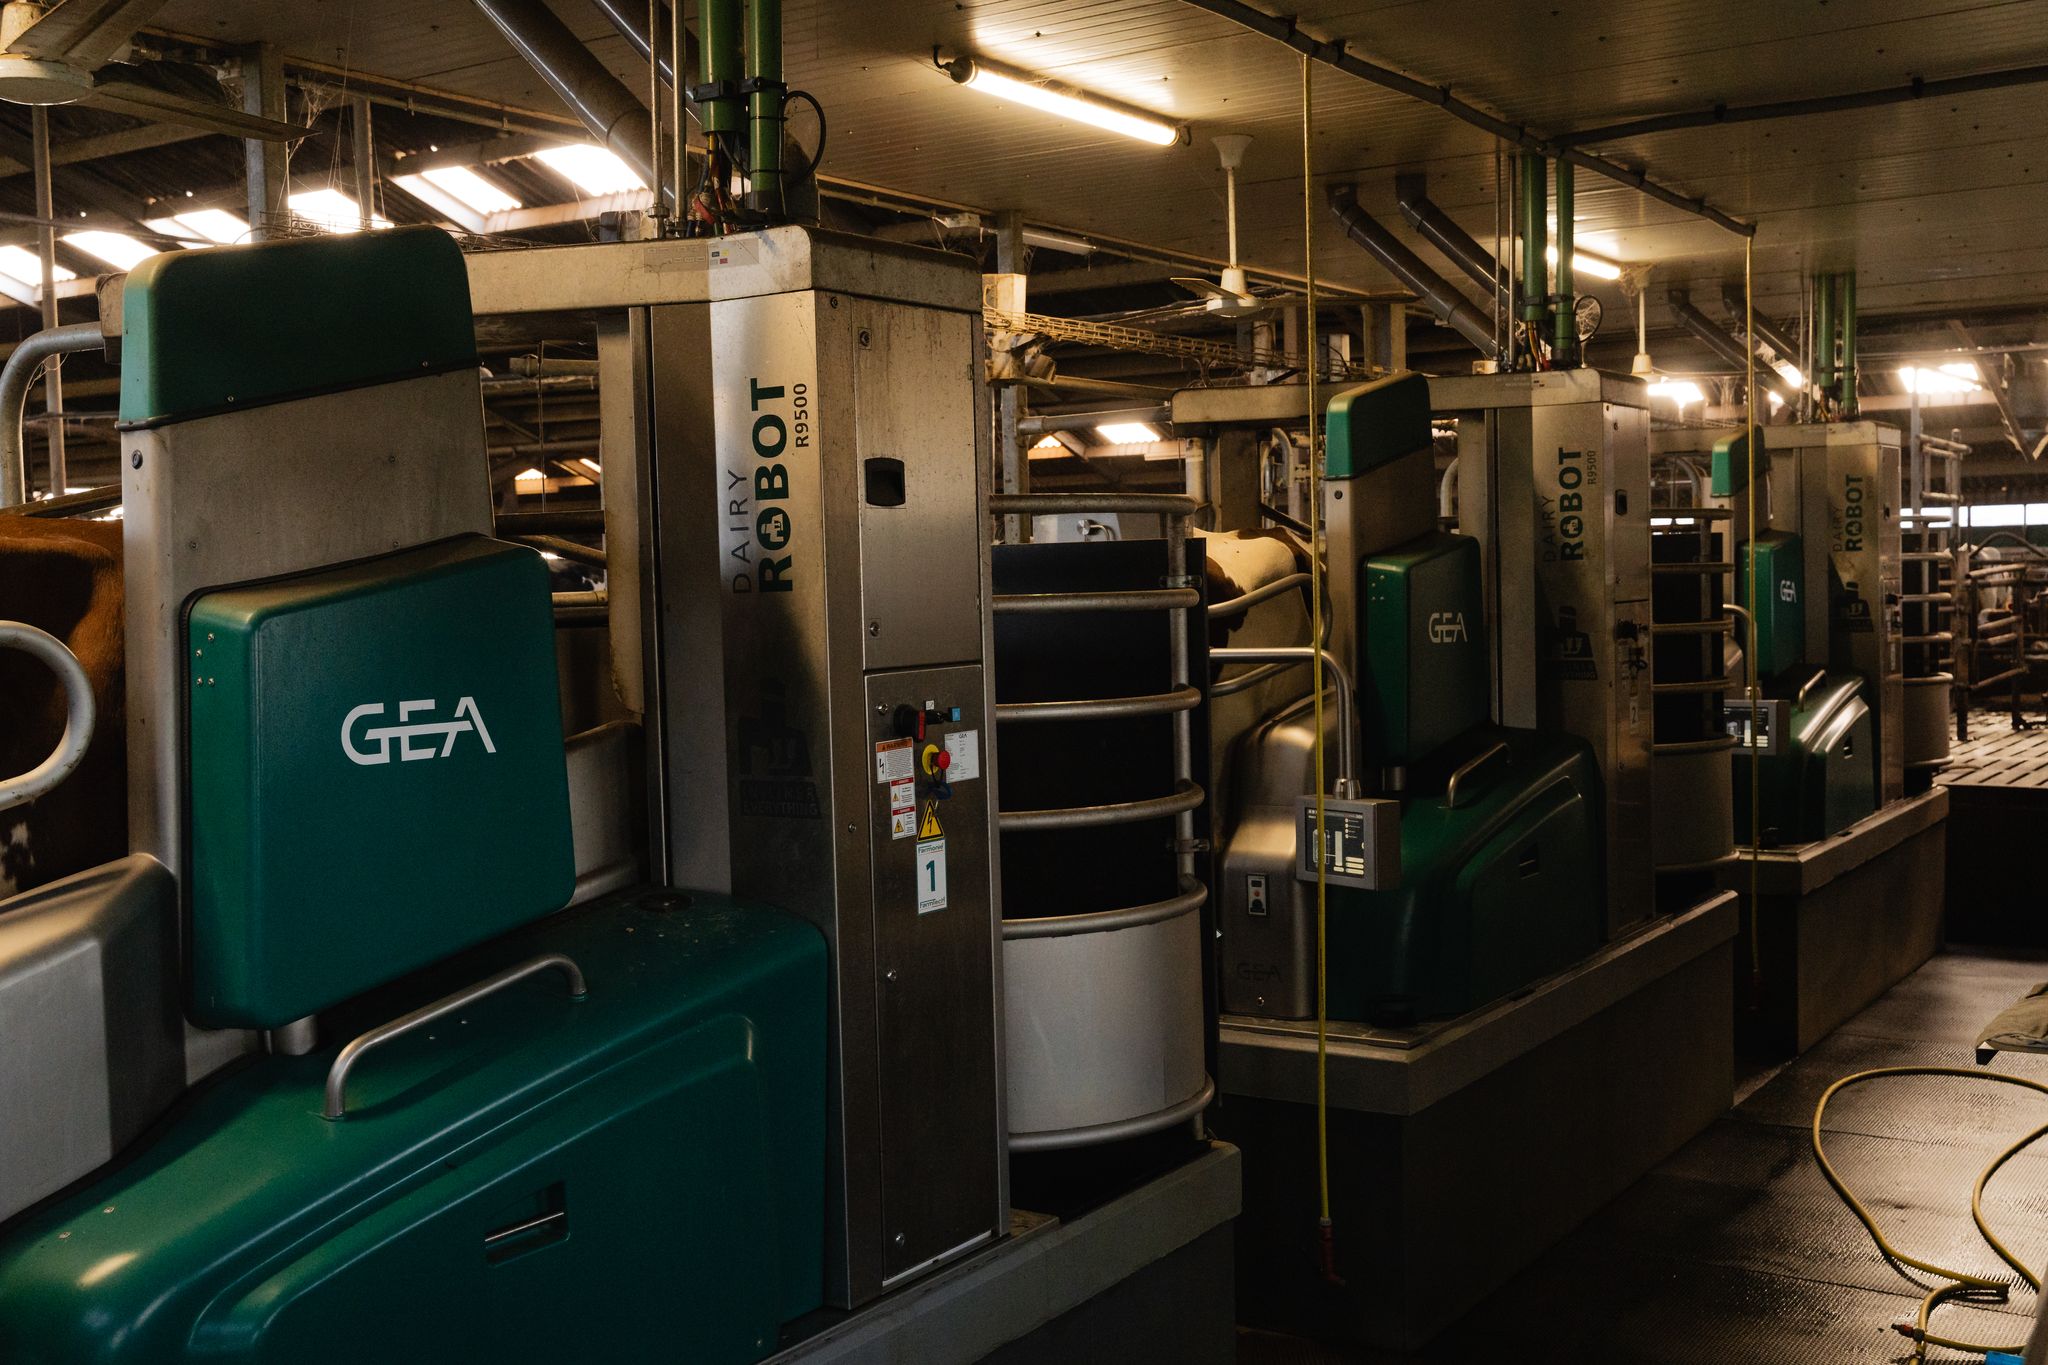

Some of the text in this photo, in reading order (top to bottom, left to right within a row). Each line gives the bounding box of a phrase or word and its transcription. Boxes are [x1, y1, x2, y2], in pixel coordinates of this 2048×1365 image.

[794, 383, 809, 448] R9500
[750, 377, 793, 593] ROBOT
[1587, 450, 1597, 485] R9500
[728, 469, 751, 594] DAIRY
[1542, 495, 1556, 562] DAIRY
[1558, 447, 1584, 561] ROBOT
[1831, 506, 1842, 552] DAIRY
[1845, 474, 1863, 552] ROBOT
[1779, 579, 1797, 604] GEA
[1428, 612, 1468, 643] GEA
[340, 696, 497, 766] GEA
[926, 860, 936, 892] 1
[1236, 962, 1284, 983] GEA
